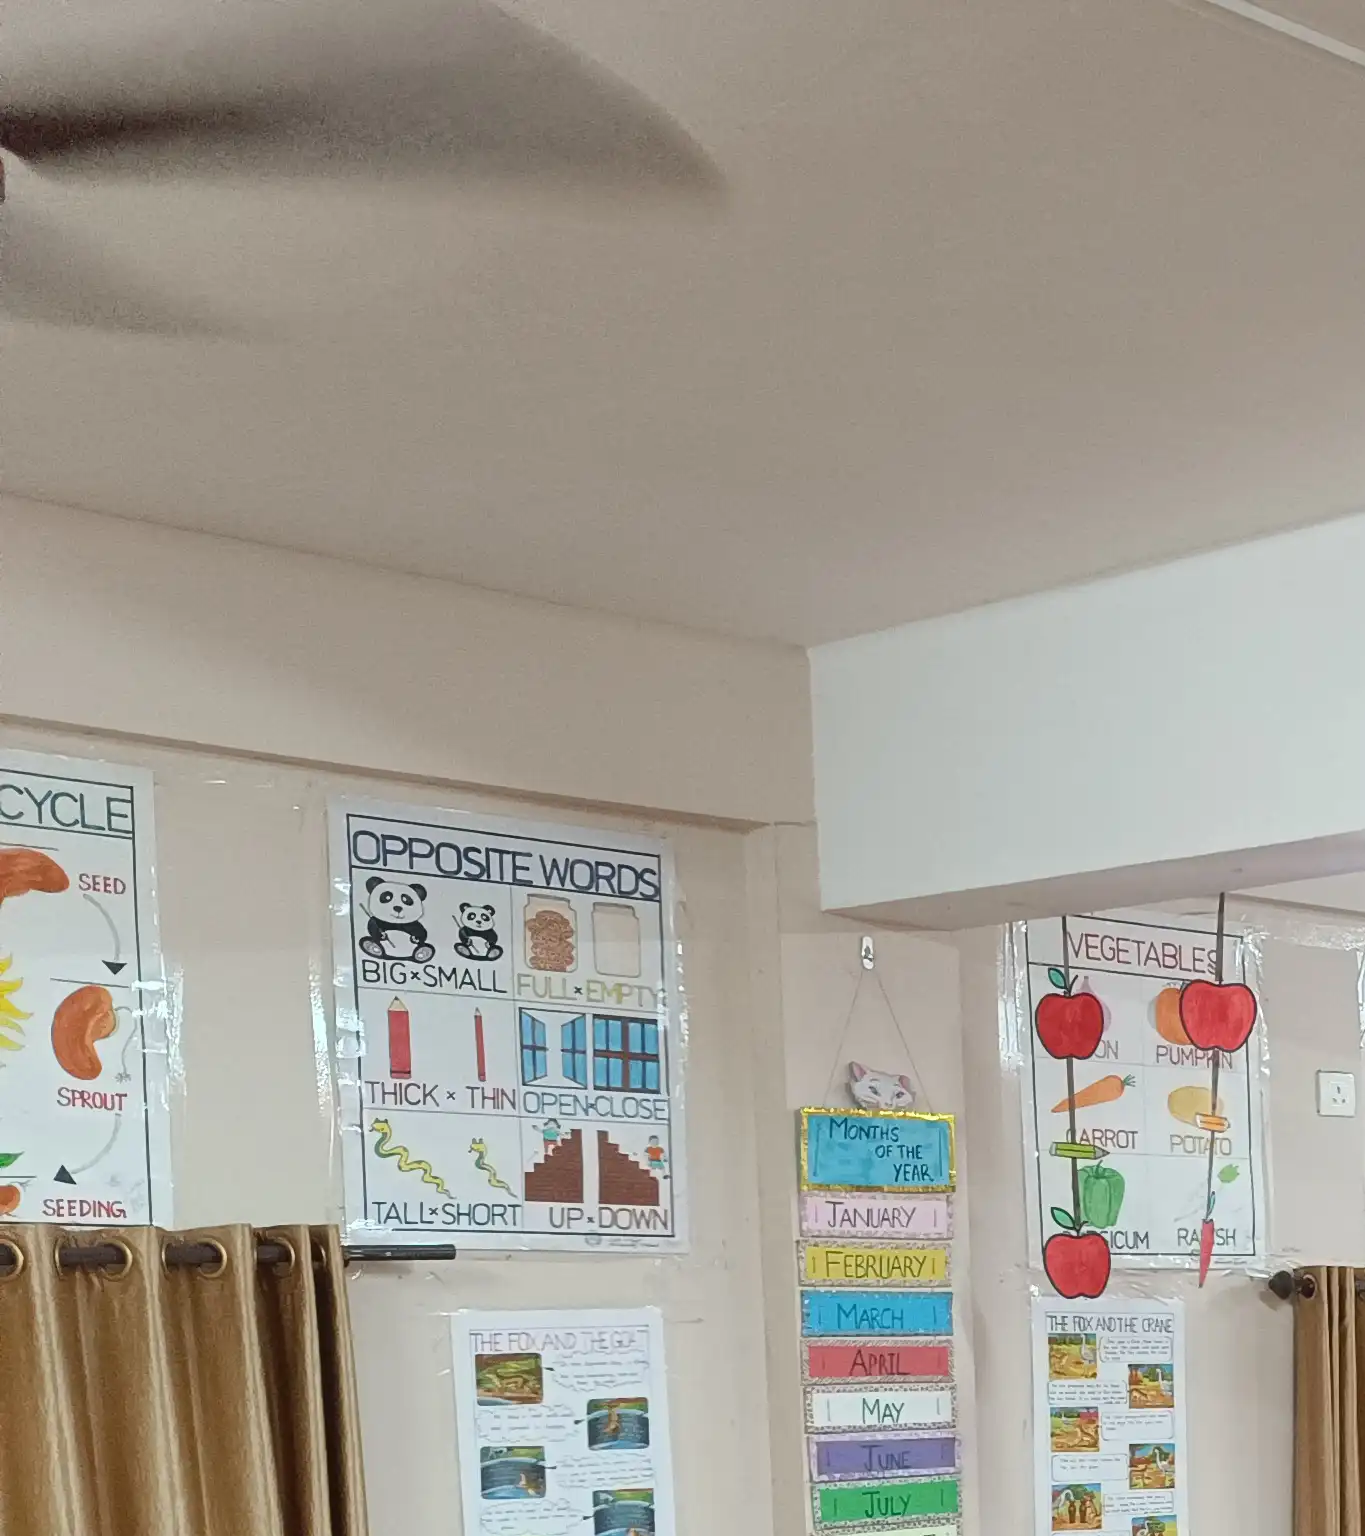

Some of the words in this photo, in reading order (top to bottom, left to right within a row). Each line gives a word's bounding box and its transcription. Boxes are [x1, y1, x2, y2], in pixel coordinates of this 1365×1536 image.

[0, 782, 133, 835] CYCLE
[351, 830, 533, 887] OPPOSITE
[539, 855, 660, 900] WORDS
[78, 872, 126, 896] SEED
[1066, 931, 1219, 976] VEGETABLES
[361, 959, 408, 985] BIG
[422, 964, 508, 995] SMALL
[516, 973, 573, 998] FULL
[56, 1087, 128, 1114] SPROUT
[364, 1080, 440, 1107] THICK
[465, 1085, 516, 1110] THIN
[523, 1090, 587, 1117] OPEN
[594, 1094, 669, 1122] CLOSE
[829, 1117, 900, 1142] MONTHS
[1065, 1129, 1139, 1150] CARROT
[875, 1145, 893, 1158] OF
[898, 1145, 923, 1160] THE
[1169, 1134, 1232, 1156] POTATO
[893, 1163, 935, 1183] YEAR
[42, 1197, 127, 1220] SEEDING
[372, 1201, 430, 1226] TALL
[440, 1202, 523, 1228] SHORT
[548, 1206, 585, 1231] UP
[597, 1206, 670, 1232] DOWN
[825, 1201, 917, 1229] JANUARY
[1177, 1228, 1236, 1247] RASH
[825, 1250, 927, 1279] FEBRUARY
[836, 1304, 904, 1330] MARCH
[1046, 1314, 1069, 1332] THE
[470, 1332, 503, 1352] THE
[850, 1349, 911, 1376] APRIL
[862, 1398, 905, 1424] MAY
[864, 1445, 912, 1471] JUNE
[862, 1491, 911, 1518] JULY
